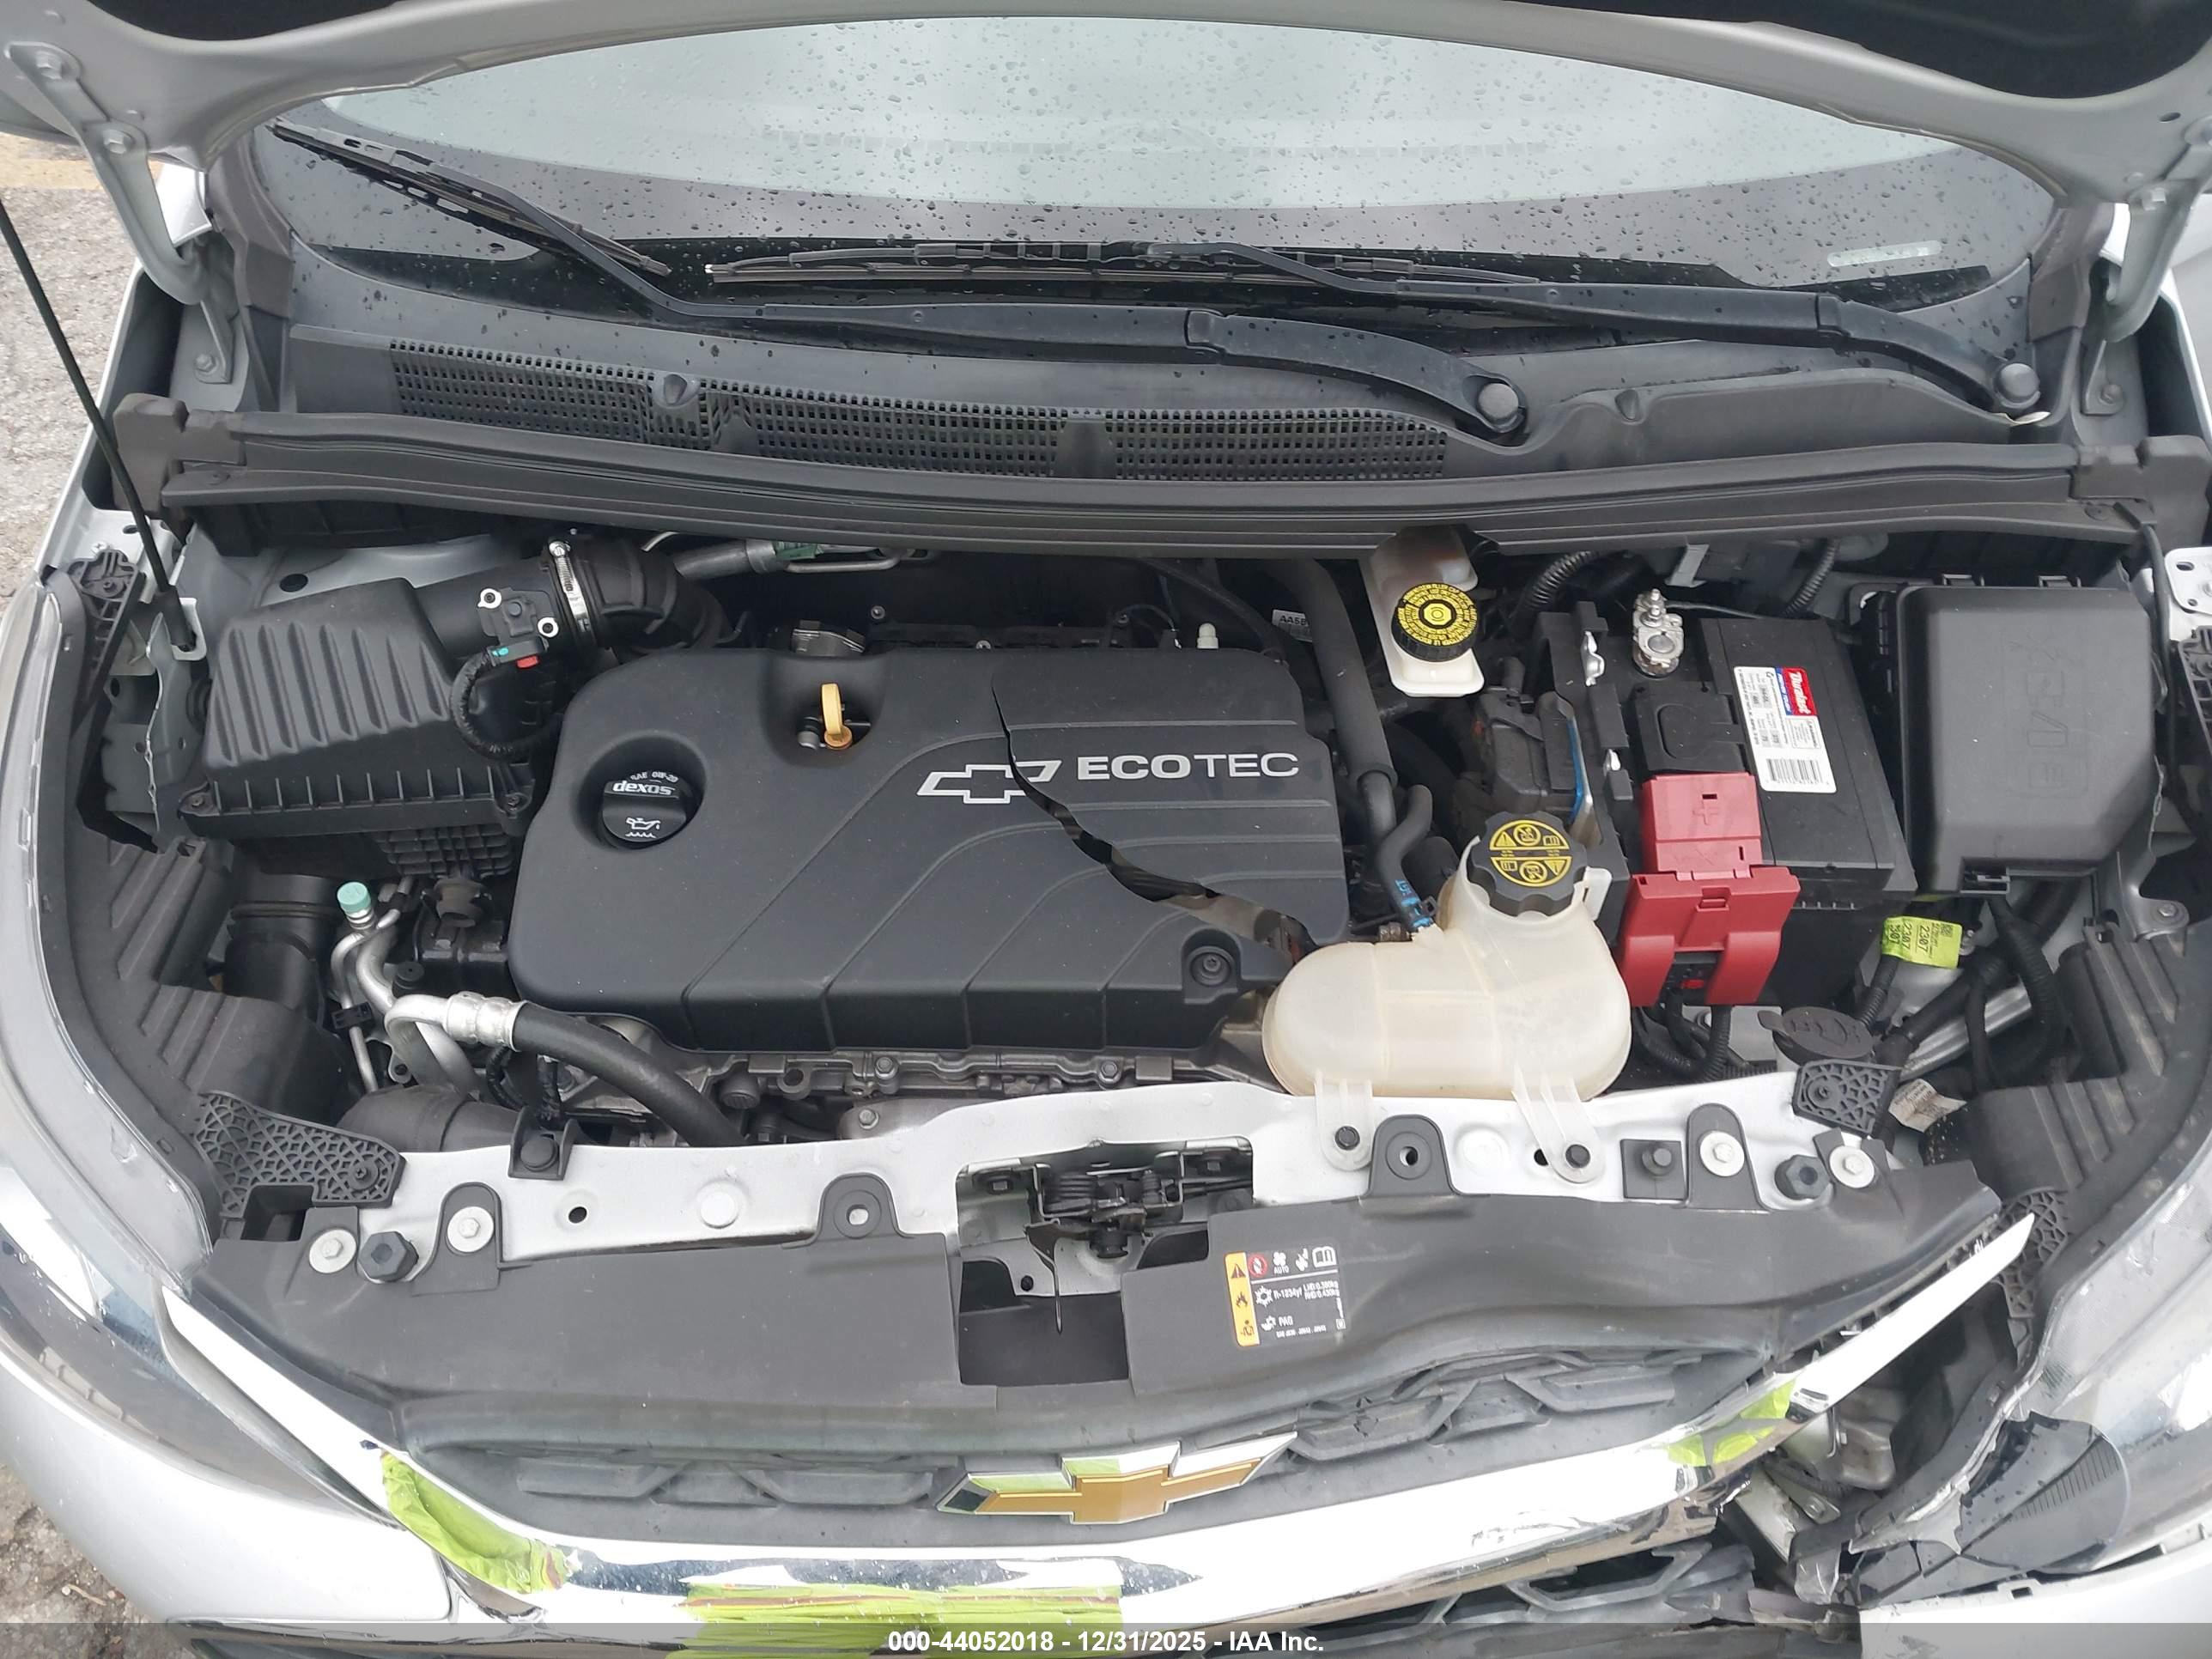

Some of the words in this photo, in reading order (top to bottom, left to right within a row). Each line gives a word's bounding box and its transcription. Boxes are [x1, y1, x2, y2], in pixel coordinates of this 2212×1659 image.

[1789, 671, 1811, 714] Duralast
[1077, 753, 1299, 781] ECOTEC
[612, 780, 676, 795] dexos
[1917, 925, 1930, 954] 2307
[1273, 1266, 1290, 1274] AUTO
